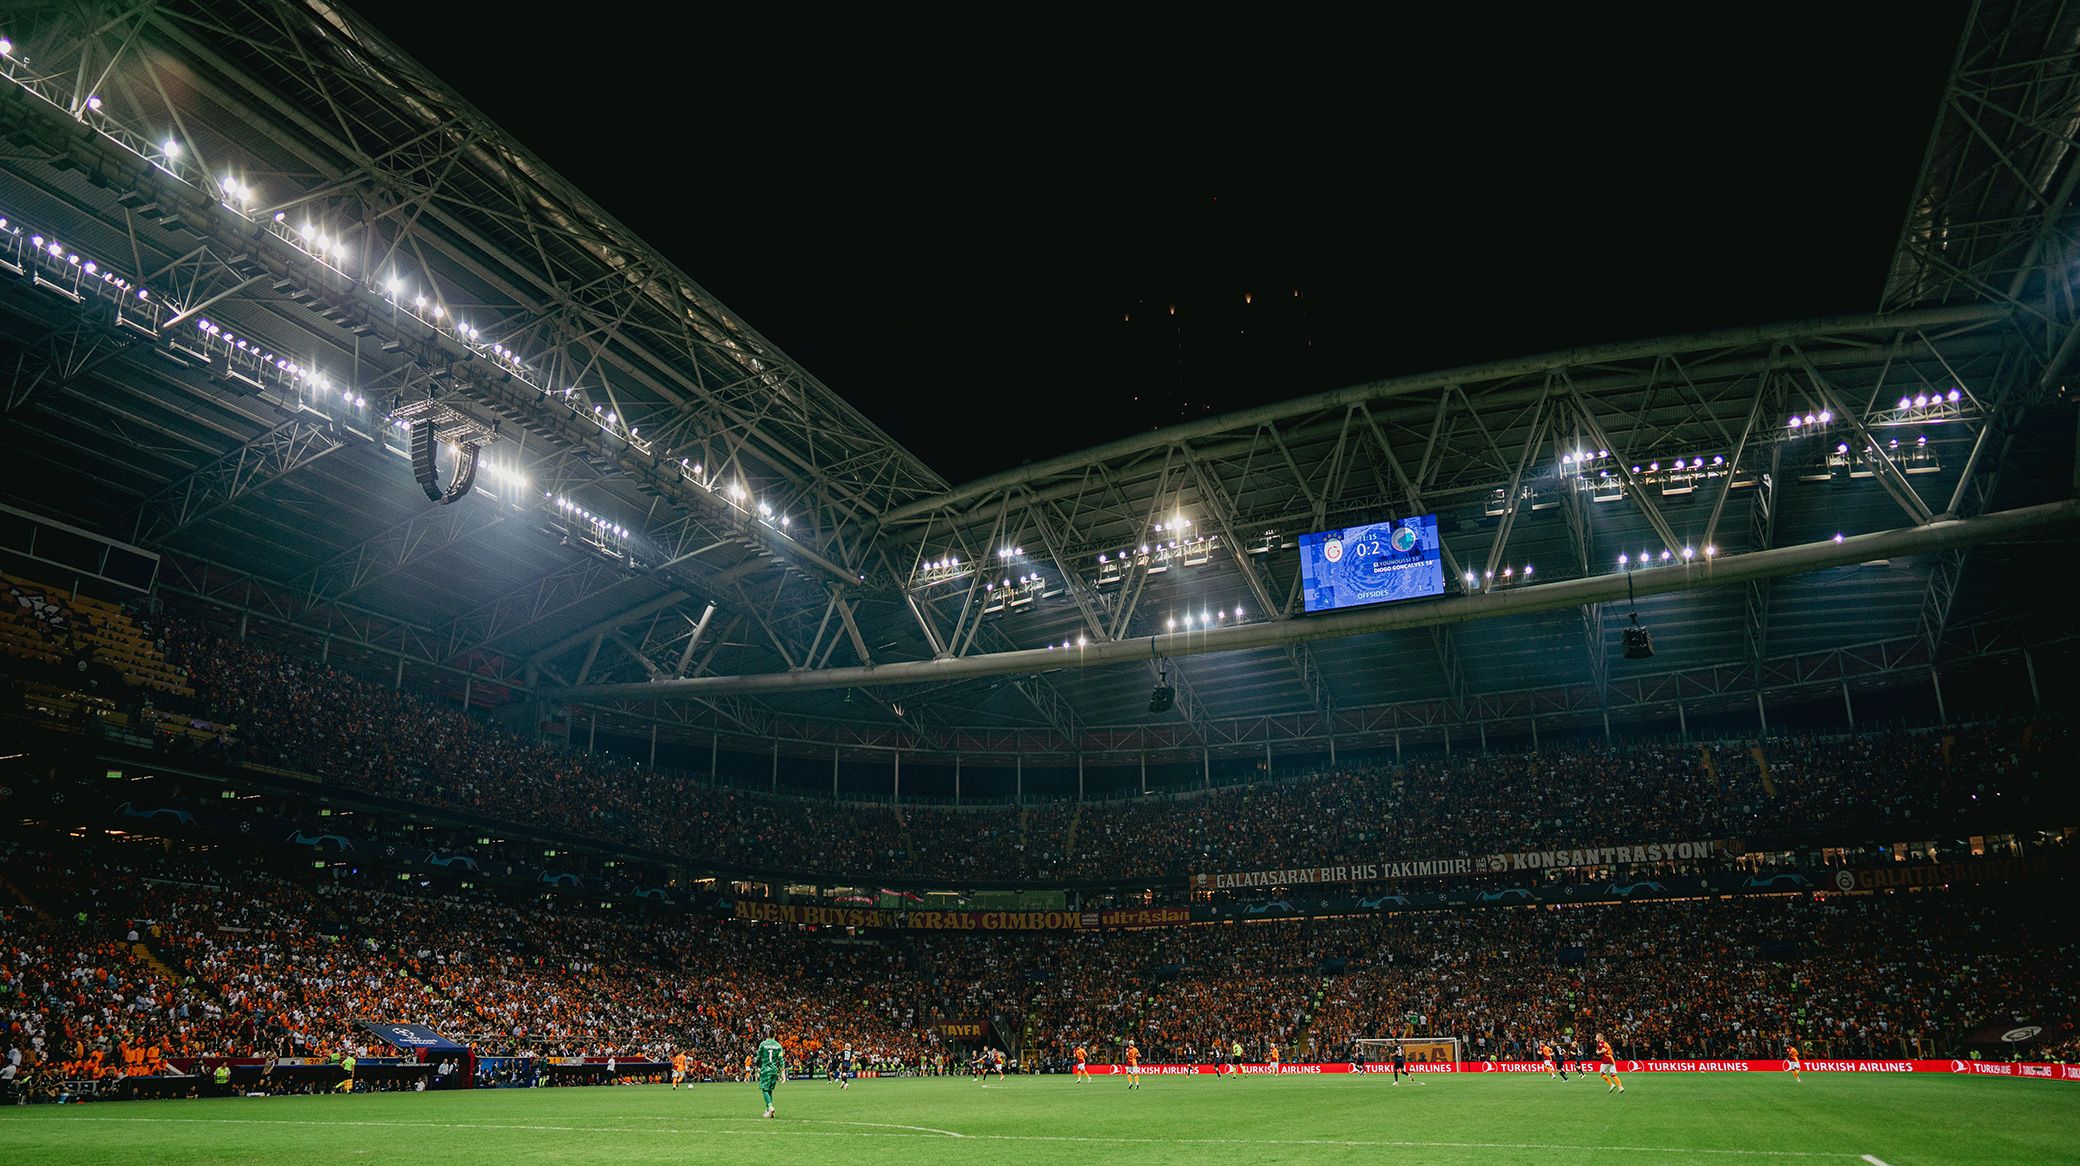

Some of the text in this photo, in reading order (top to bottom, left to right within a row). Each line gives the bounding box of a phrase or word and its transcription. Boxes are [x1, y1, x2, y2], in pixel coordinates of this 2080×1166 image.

[1357, 541, 1380, 557] 0:2
[1357, 590, 1389, 599] OFFSIDES
[1514, 841, 1714, 870] KONSANTRASYON!
[1216, 868, 1317, 888] GALATASARAY
[1381, 858, 1471, 878] TAKIMIDIR!
[908, 911, 976, 929] KRAL
[1102, 908, 1190, 925] ultrAslan
[939, 1024, 981, 1037] TAYFA
[1281, 1065, 1321, 1074] AIRLINES
[1409, 1064, 1452, 1073] AIRLINES
[1501, 1063, 1545, 1072] TURKISH
[1647, 1062, 1749, 1072] TURKISH AIRLINES
[1804, 1062, 1914, 1073] TURKISH AIRLINES
